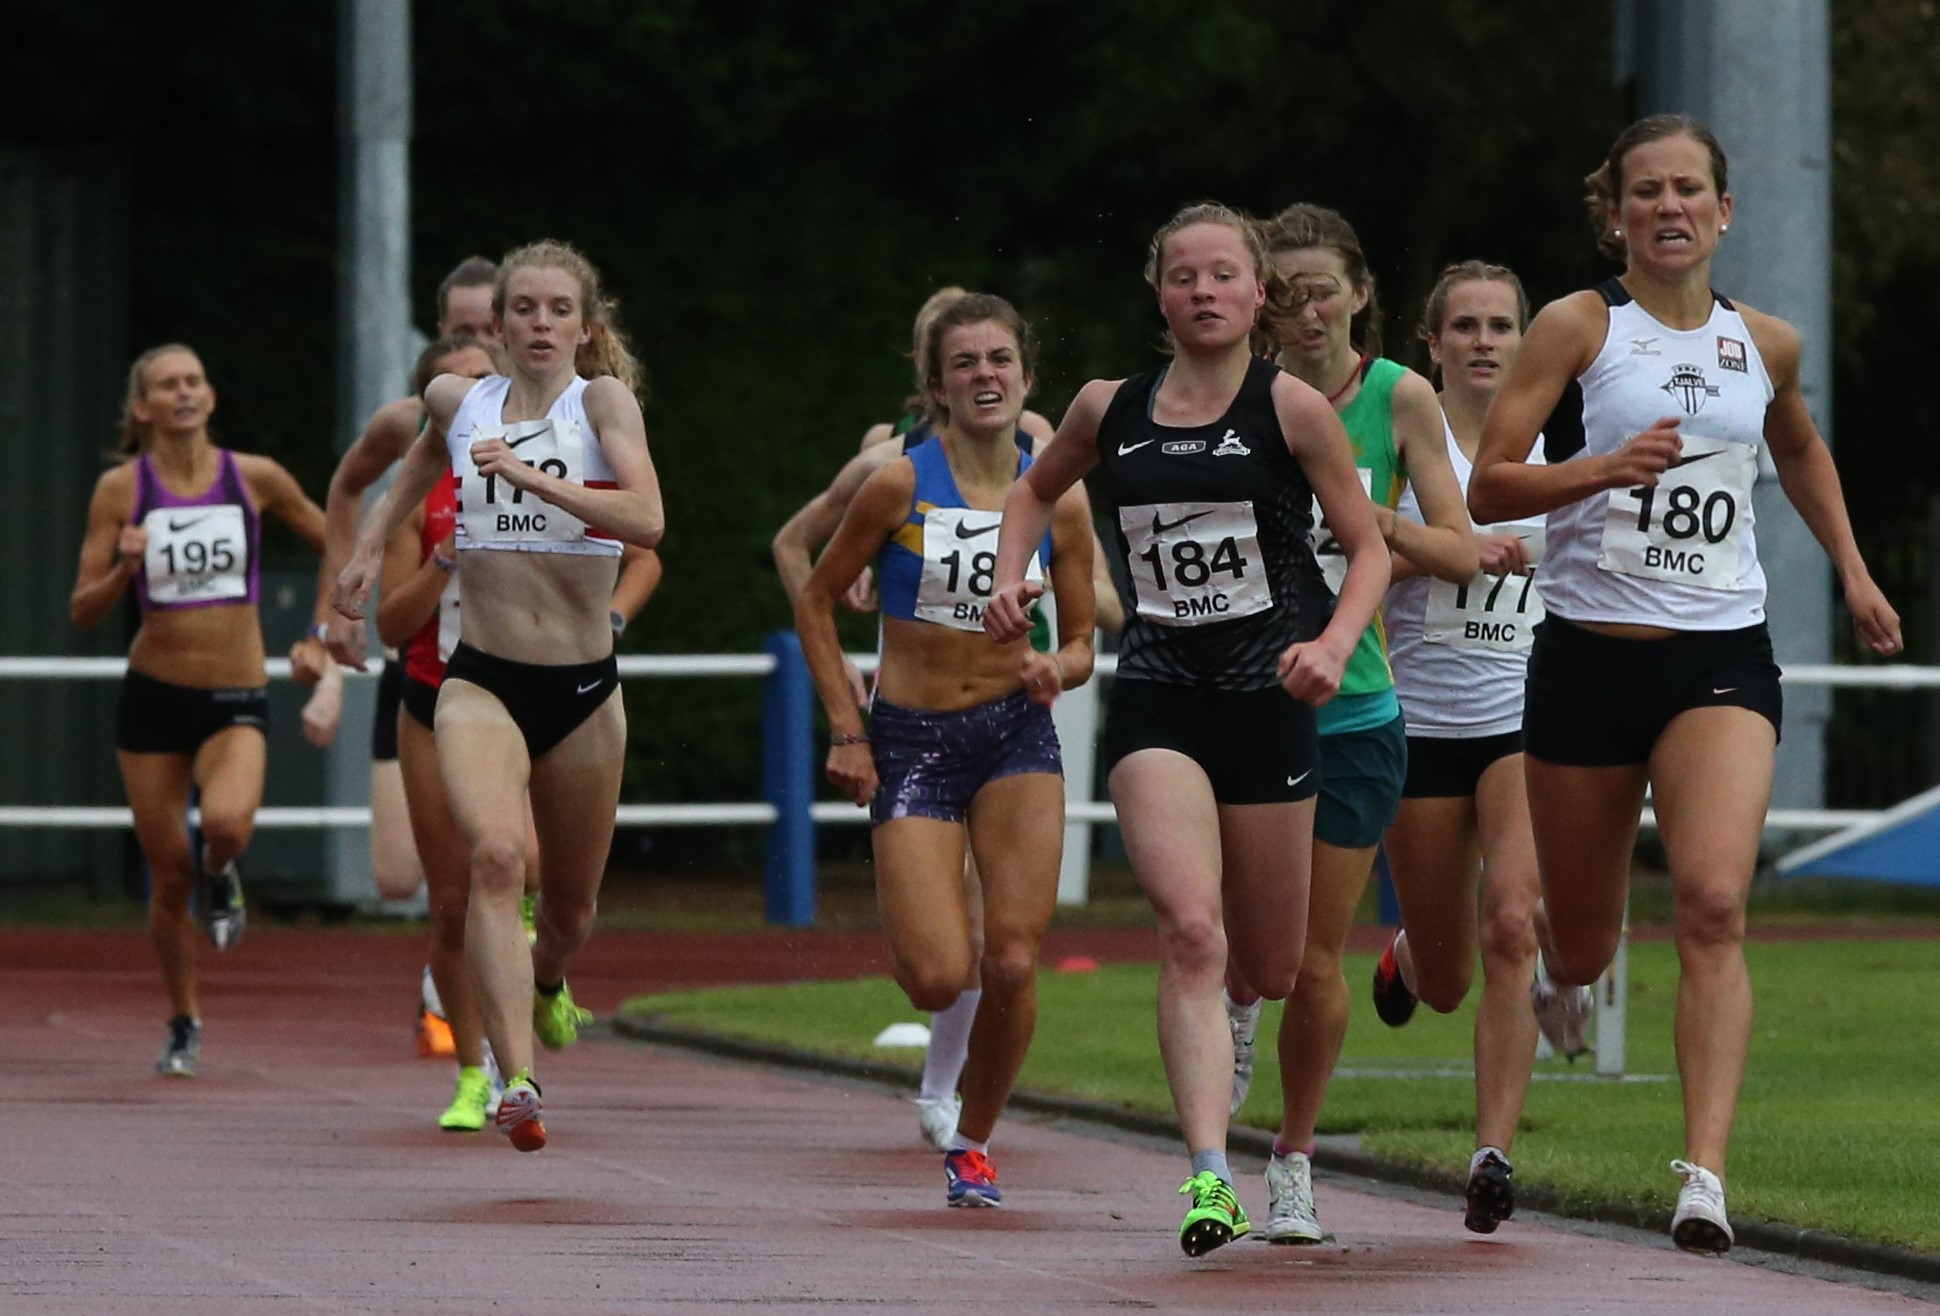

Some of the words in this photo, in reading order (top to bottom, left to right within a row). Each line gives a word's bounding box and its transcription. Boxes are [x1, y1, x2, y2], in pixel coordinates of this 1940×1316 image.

[496, 514, 546, 531] BMC
[1630, 485, 1735, 544] 180
[159, 537, 234, 575] 195
[1140, 536, 1247, 591] 184
[1645, 547, 1705, 574] BMC
[940, 549, 996, 597] 18
[953, 603, 986, 622] BM
[1173, 594, 1230, 617] BMC
[1464, 621, 1516, 642] BMC
